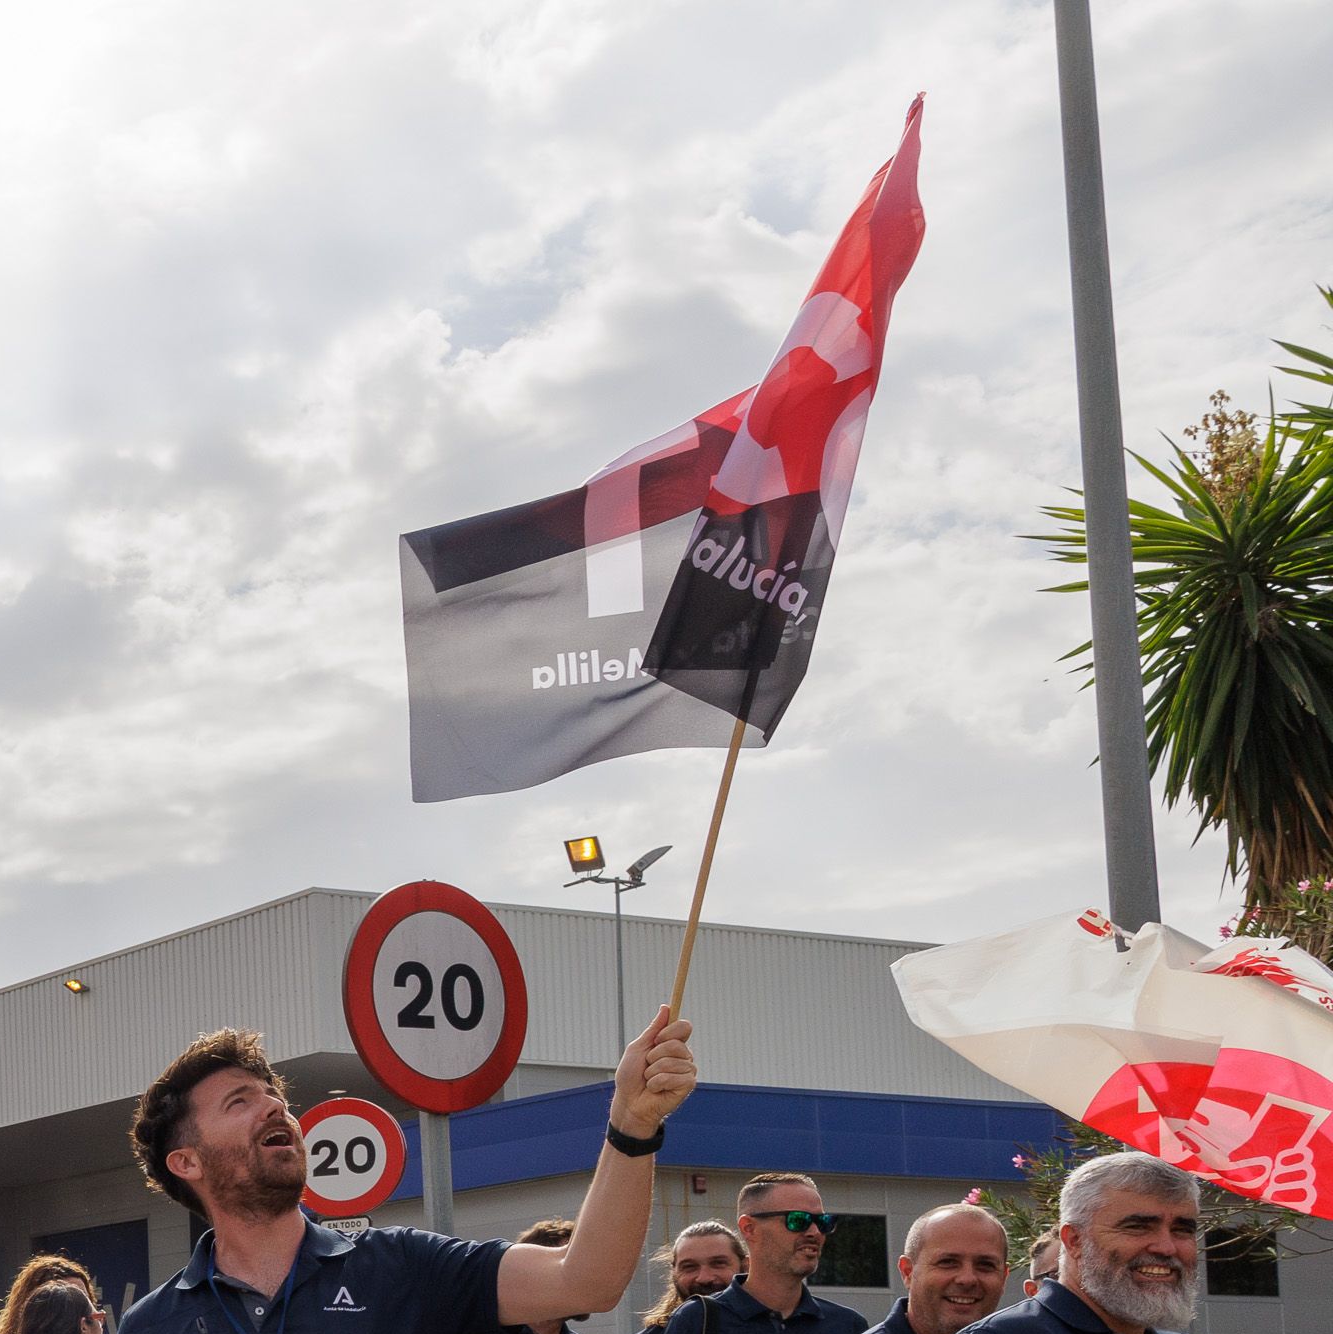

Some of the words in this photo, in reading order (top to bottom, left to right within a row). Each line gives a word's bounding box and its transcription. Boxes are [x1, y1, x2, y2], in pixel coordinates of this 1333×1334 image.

[393, 960, 485, 1032] 20
[311, 1136, 376, 1178] 20
[341, 1220, 362, 1228] TODO
